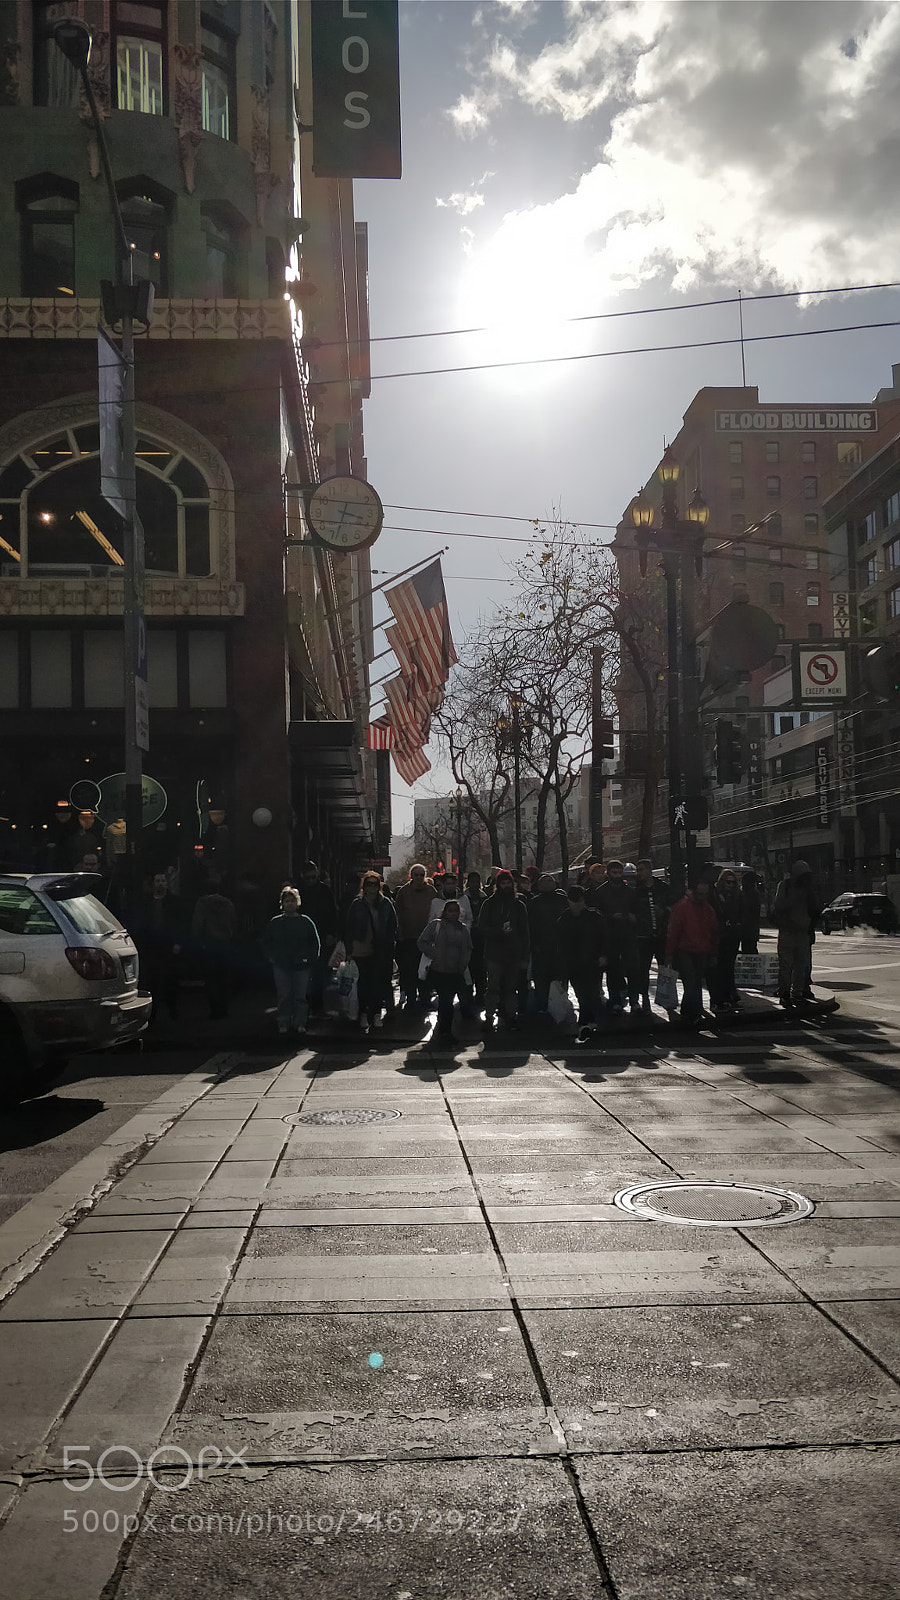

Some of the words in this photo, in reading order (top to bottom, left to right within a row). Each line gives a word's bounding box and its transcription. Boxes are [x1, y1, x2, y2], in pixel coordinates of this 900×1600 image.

[719, 413, 779, 429] FLOOD
[782, 413, 872, 429] BUILDING
[805, 687, 825, 695] EXCEPT
